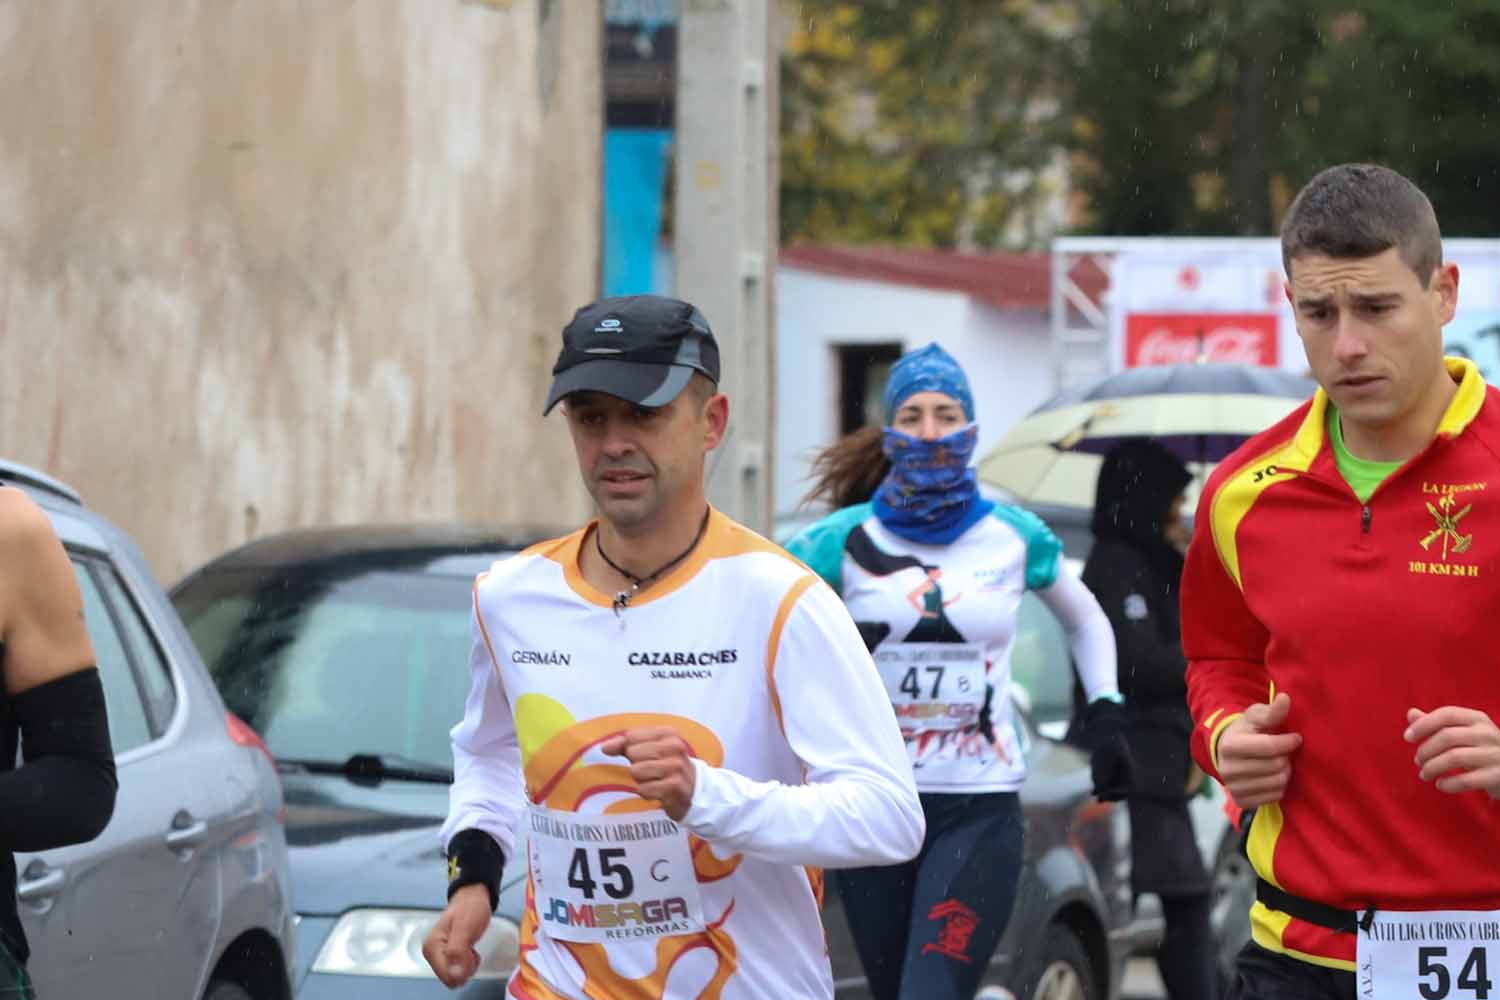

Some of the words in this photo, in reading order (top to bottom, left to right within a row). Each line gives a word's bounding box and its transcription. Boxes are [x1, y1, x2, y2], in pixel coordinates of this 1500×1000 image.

[1430, 562, 1450, 575] KM
[1468, 565, 1479, 577] H
[511, 650, 571, 666] GERMÁN
[627, 649, 738, 666] CAZABACHES
[900, 666, 946, 700] 47
[567, 847, 634, 899] 45
[650, 859, 670, 882] C
[544, 896, 689, 928] JOMISAGA
[605, 920, 689, 940] REFORMAS
[1400, 922, 1426, 942] LIGA
[1429, 921, 1466, 942] CROSS
[1418, 946, 1493, 1000] 54
